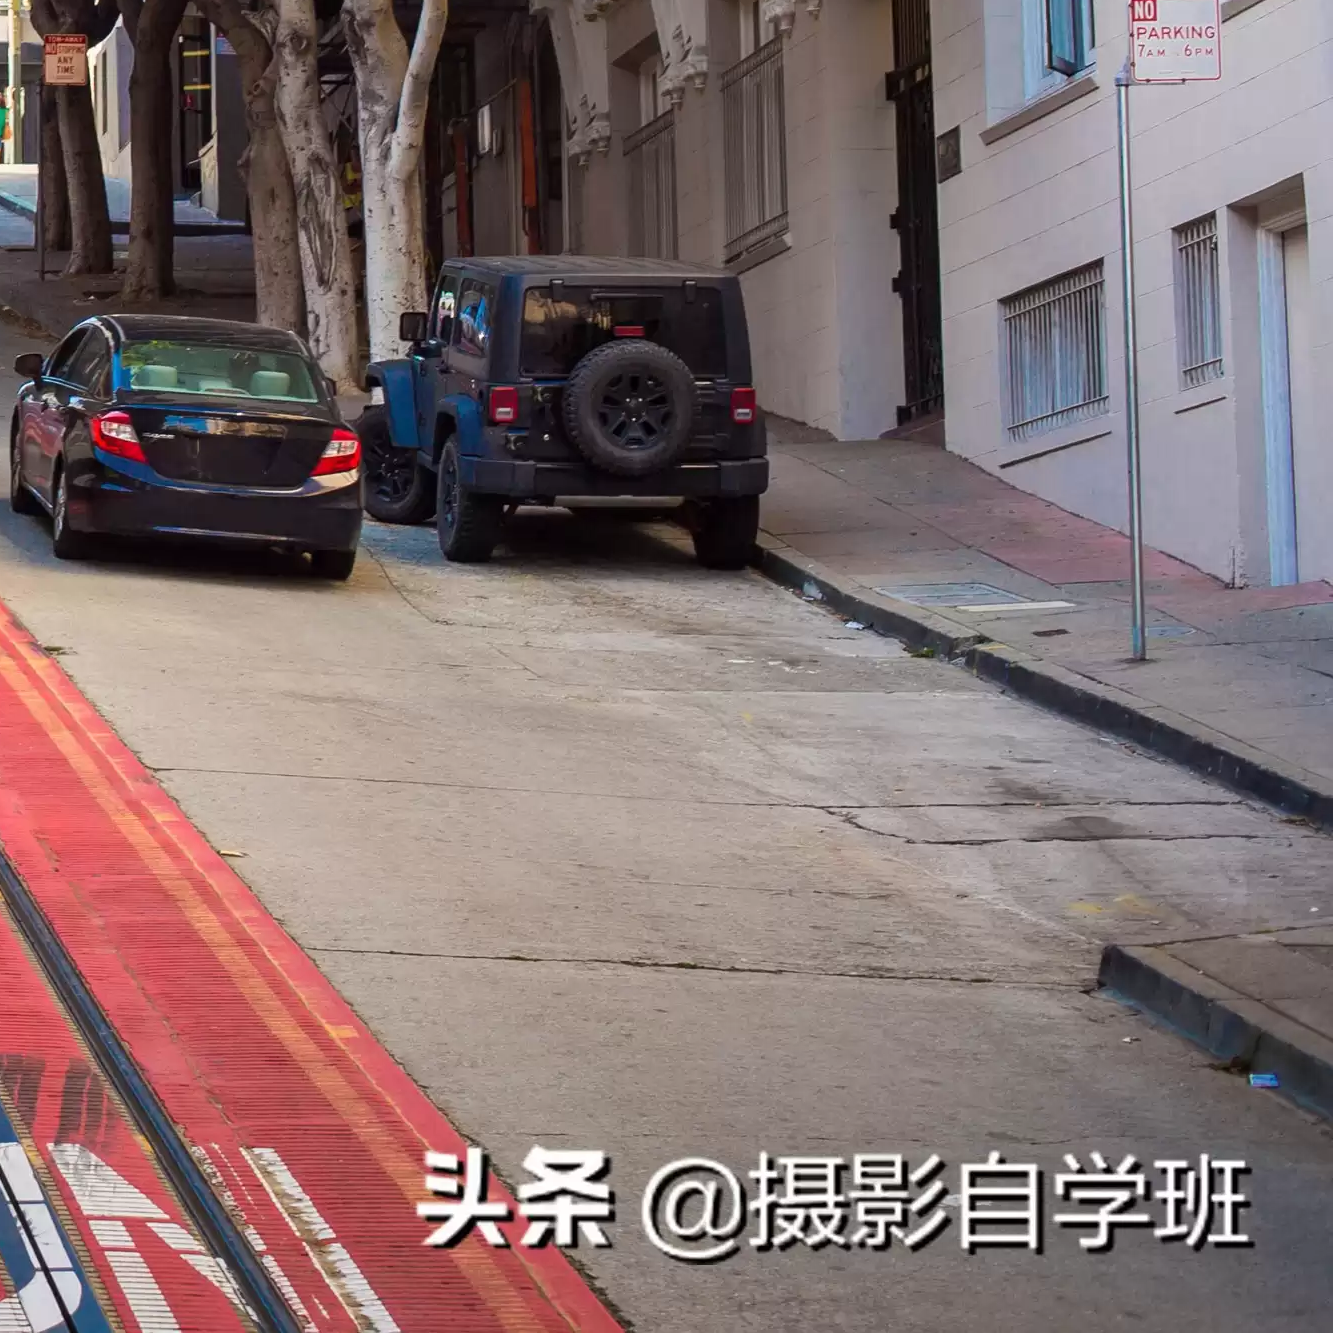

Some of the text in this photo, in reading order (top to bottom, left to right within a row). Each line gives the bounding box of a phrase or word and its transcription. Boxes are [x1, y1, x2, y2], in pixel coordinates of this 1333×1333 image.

[1134, 0, 1155, 20] NO
[1136, 26, 1215, 40] PARKING
[45, 43, 57, 54] NO
[57, 56, 74, 65] ANY
[57, 65, 75, 74] TIME
